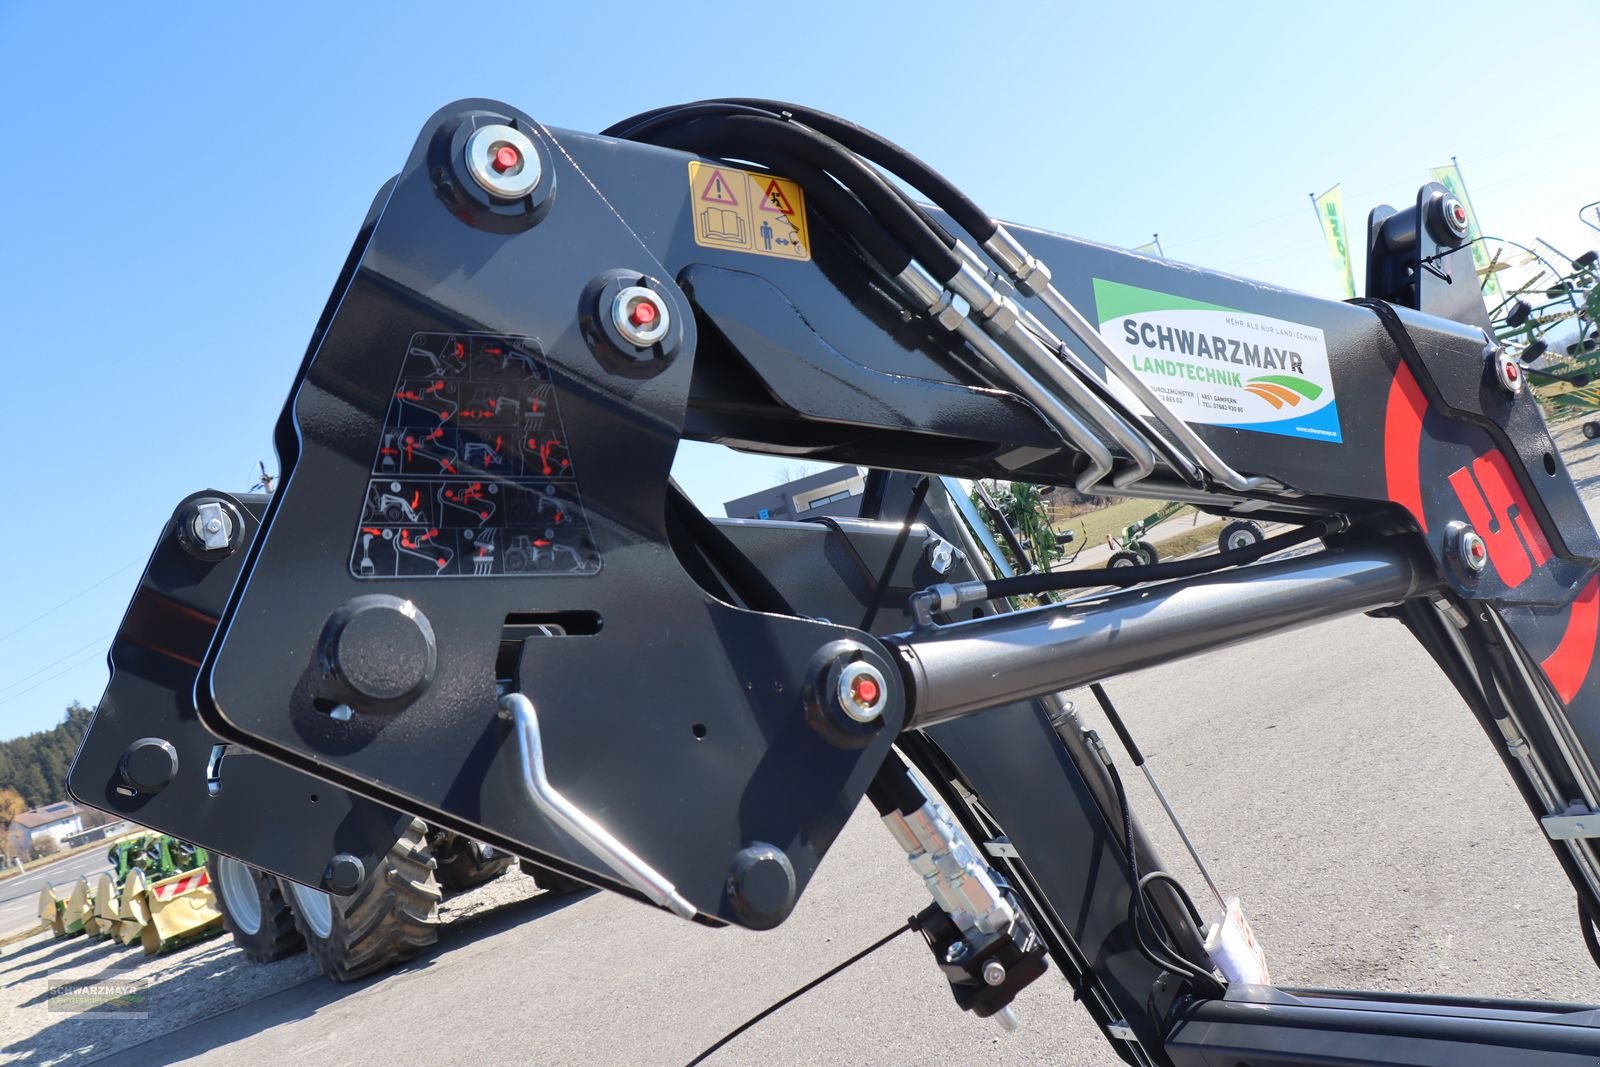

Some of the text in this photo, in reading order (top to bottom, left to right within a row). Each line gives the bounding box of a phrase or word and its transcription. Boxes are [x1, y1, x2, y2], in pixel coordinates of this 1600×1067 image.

[1225, 317, 1244, 326] MEHR
[1246, 321, 1259, 330] ALS
[1261, 324, 1274, 333] NUR
[1123, 318, 1304, 375] SCHWARZMAYR
[1132, 354, 1243, 388] LANDTECHNIK
